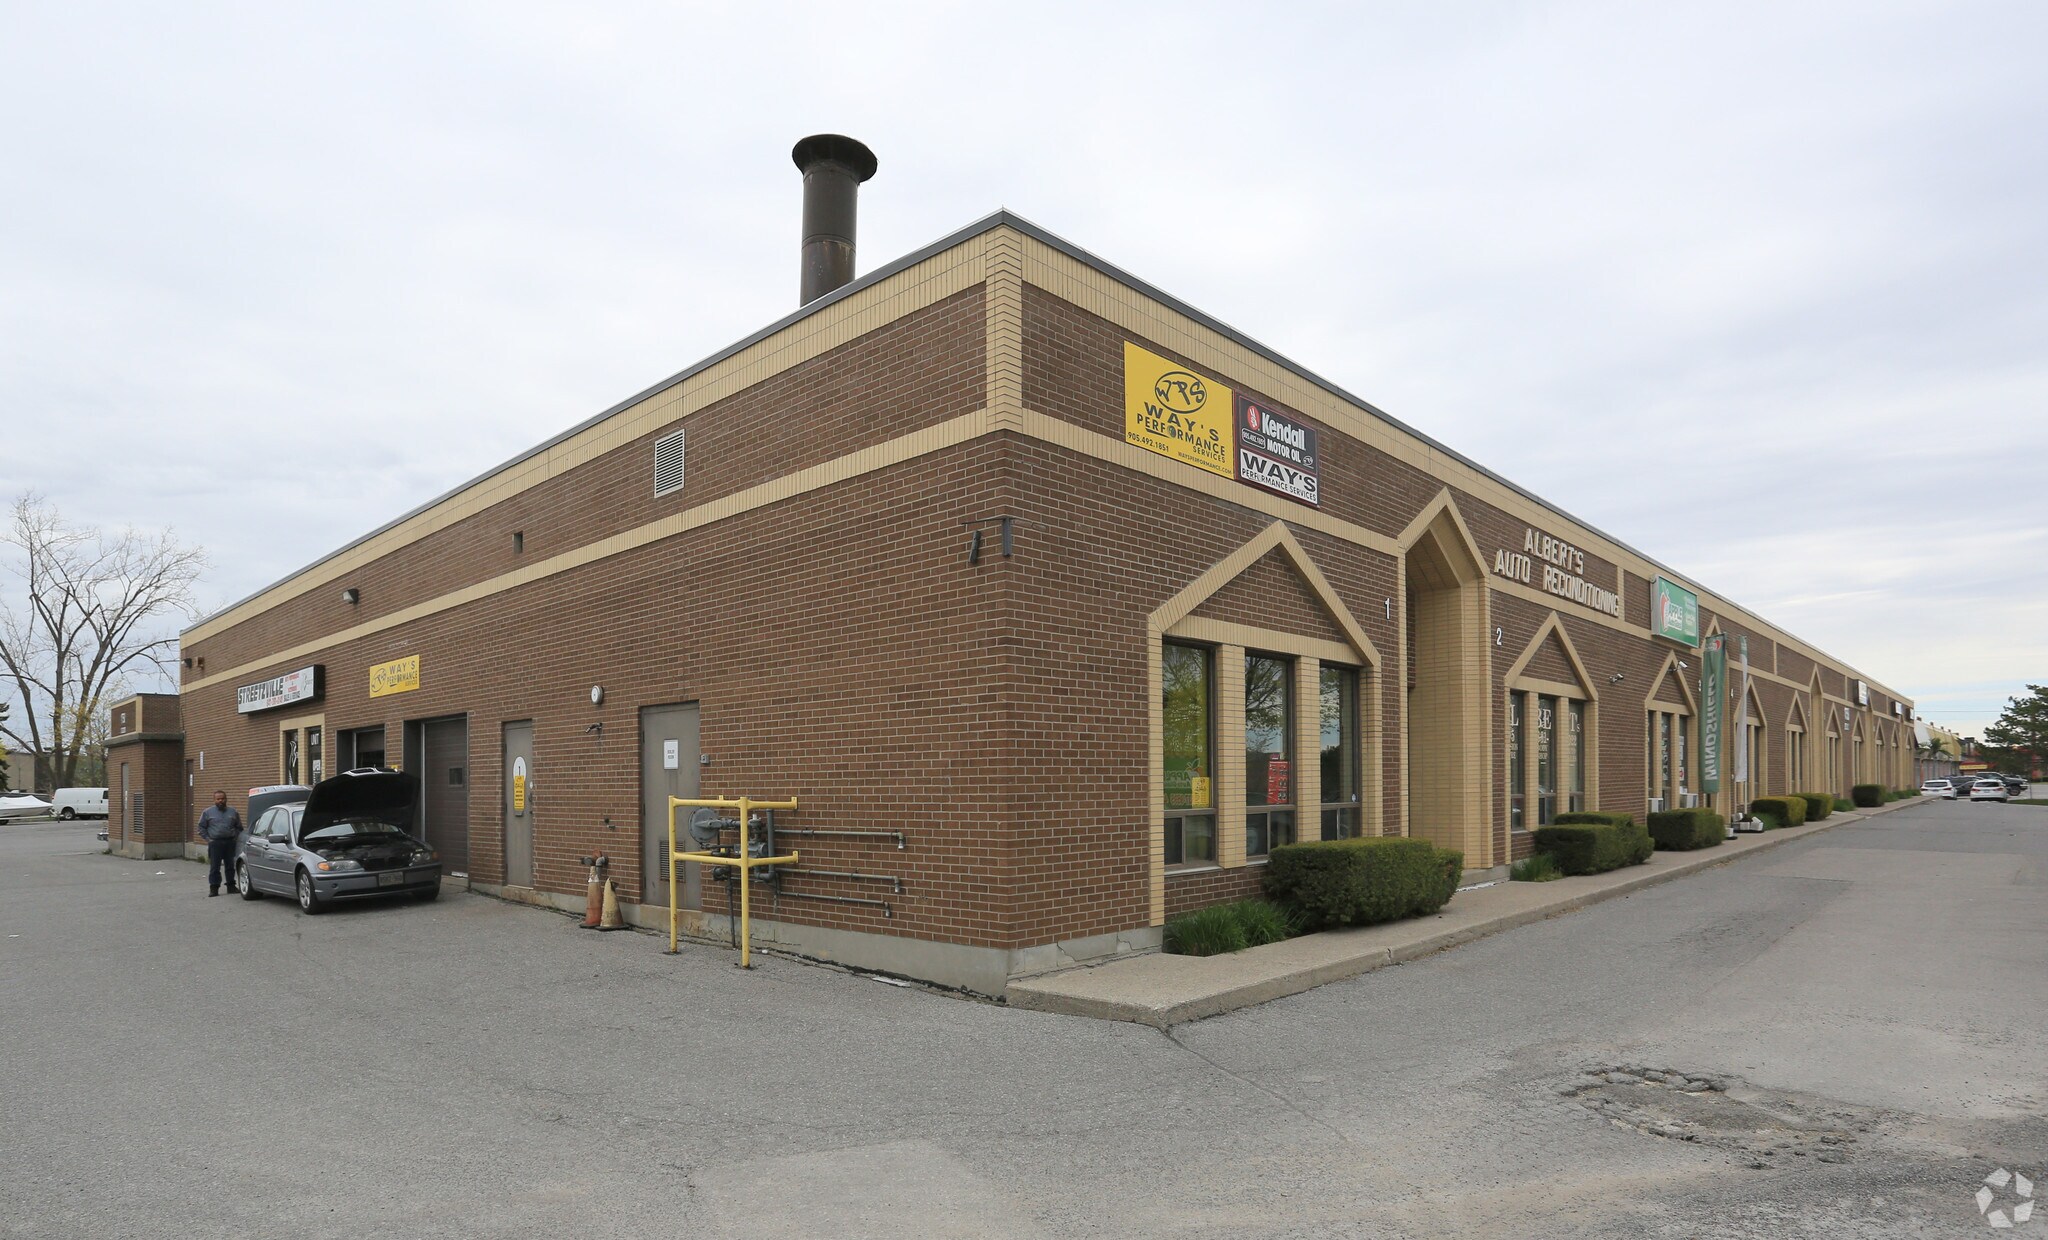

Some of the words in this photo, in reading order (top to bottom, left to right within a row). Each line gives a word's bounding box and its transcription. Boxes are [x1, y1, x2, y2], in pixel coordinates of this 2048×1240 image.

[1136, 412, 1226, 456] PERFORMANCE
[1144, 401, 1219, 442] WAY'S
[1261, 412, 1306, 451] Kendall
[1192, 445, 1226, 464] SERVICES
[1267, 438, 1291, 459] MOTOR
[1290, 448, 1302, 463] OIL
[1242, 451, 1316, 492] WAY'S
[1289, 485, 1317, 502] SERVICES
[1524, 528, 1584, 575] ALBERT'S
[1494, 549, 1531, 584] AUTO
[1542, 564, 1620, 617] RECONDITIONING
[1384, 597, 1390, 620] 1
[1496, 627, 1502, 646] 2
[238, 677, 284, 705] STREETZVILLE
